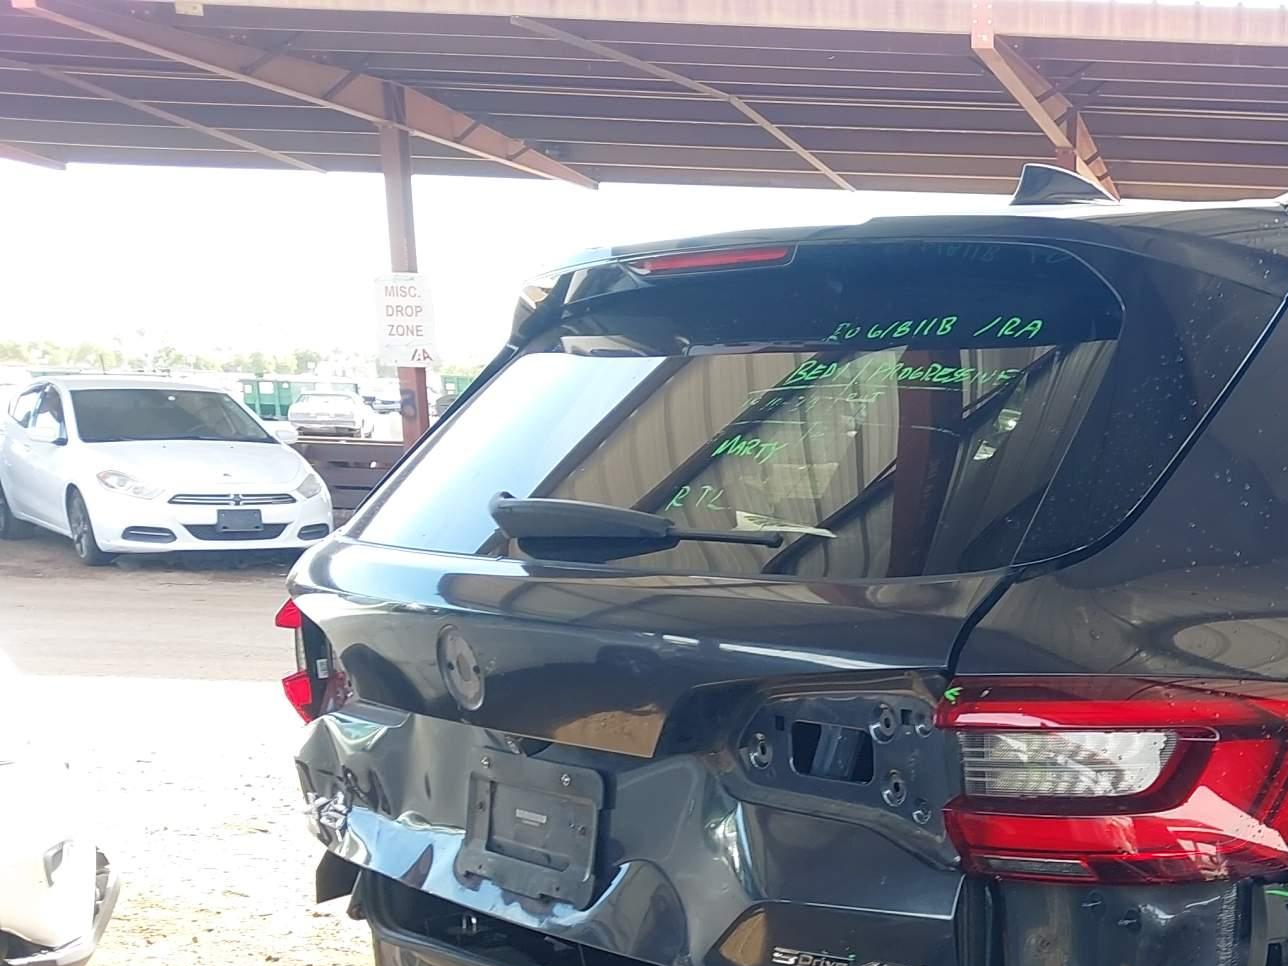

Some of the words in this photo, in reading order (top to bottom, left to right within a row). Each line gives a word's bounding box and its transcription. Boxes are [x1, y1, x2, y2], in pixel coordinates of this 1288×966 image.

[384, 285, 422, 298] MISC.
[385, 304, 424, 318] DROP
[387, 324, 424, 337] ZONE
